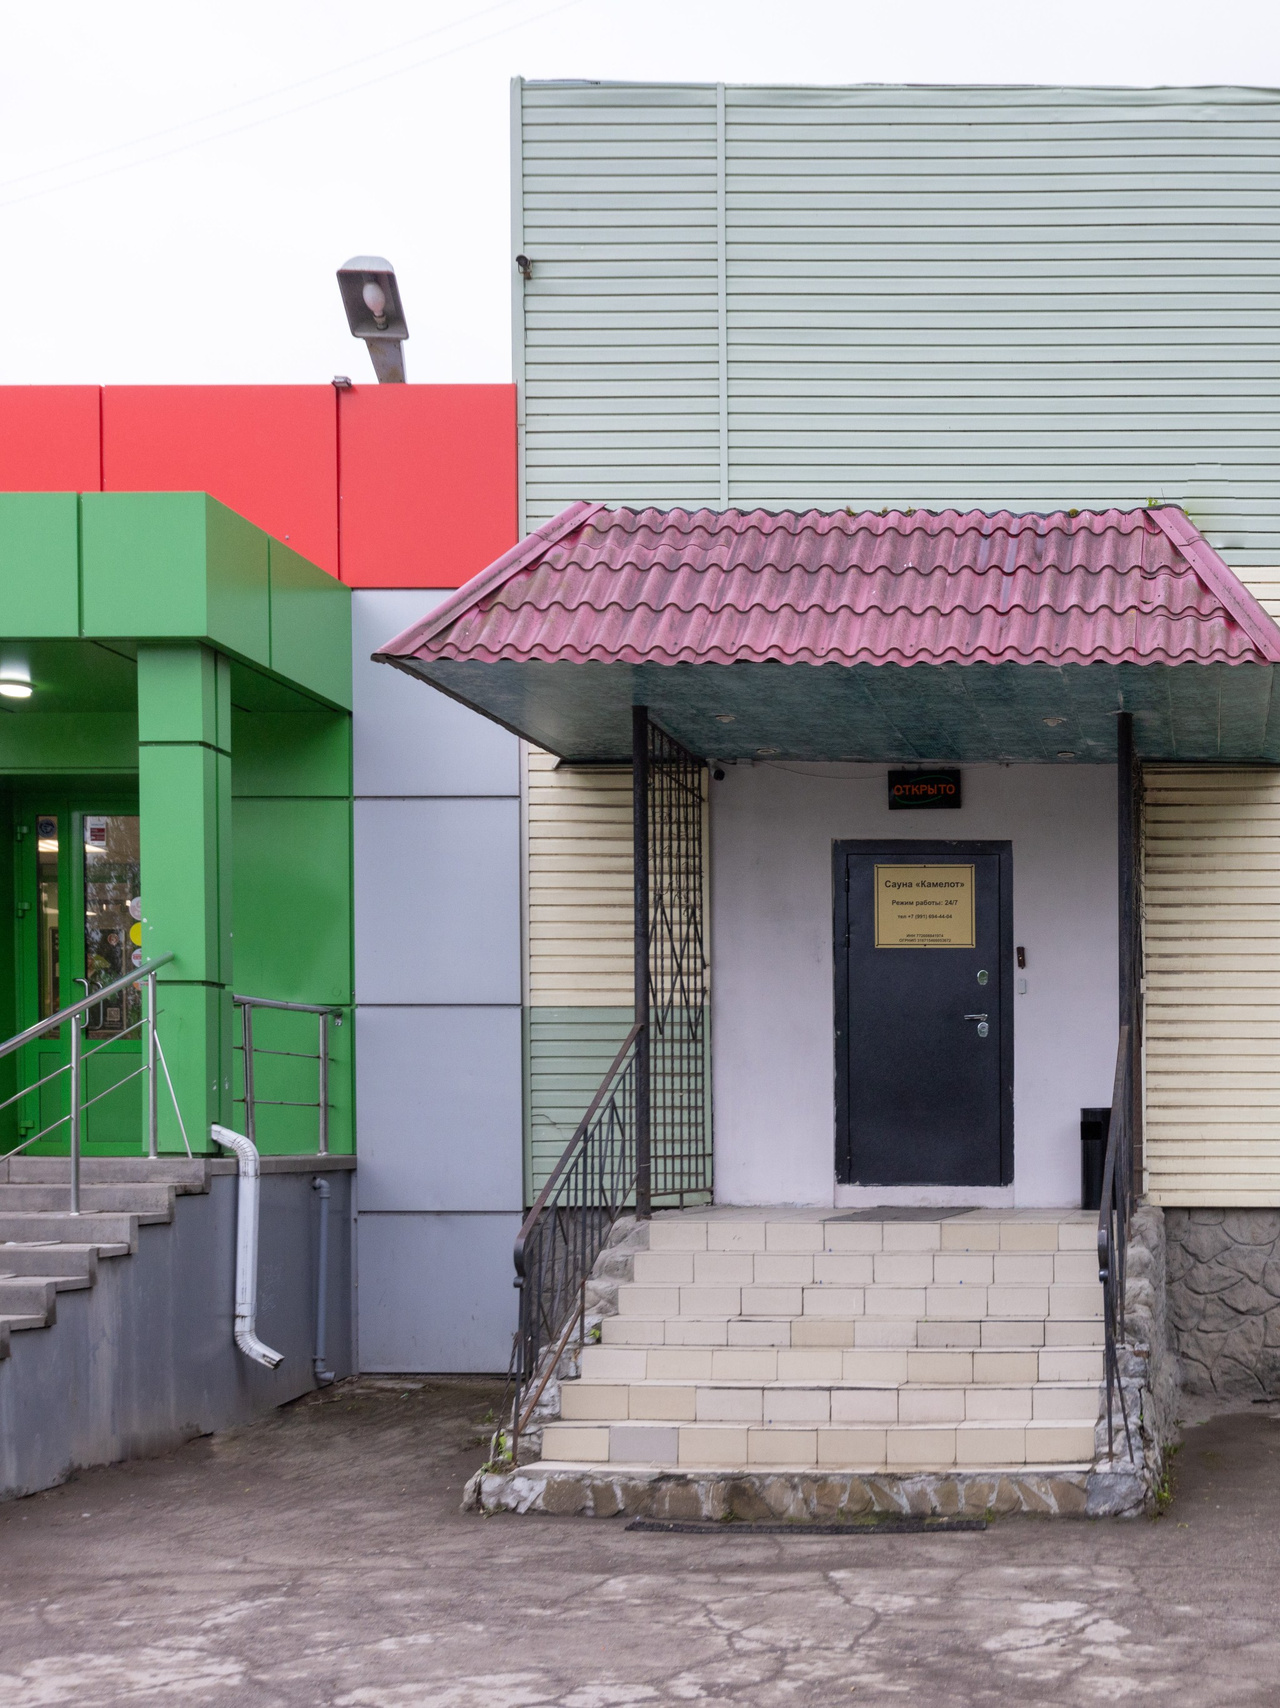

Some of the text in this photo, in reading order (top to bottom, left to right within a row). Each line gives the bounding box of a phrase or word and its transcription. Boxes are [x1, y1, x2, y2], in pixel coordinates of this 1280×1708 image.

[893, 783, 956, 796] ОТКРЫТО
[884, 880, 965, 890] Сауна «Камелот»
[915, 899, 943, 907] работы:
